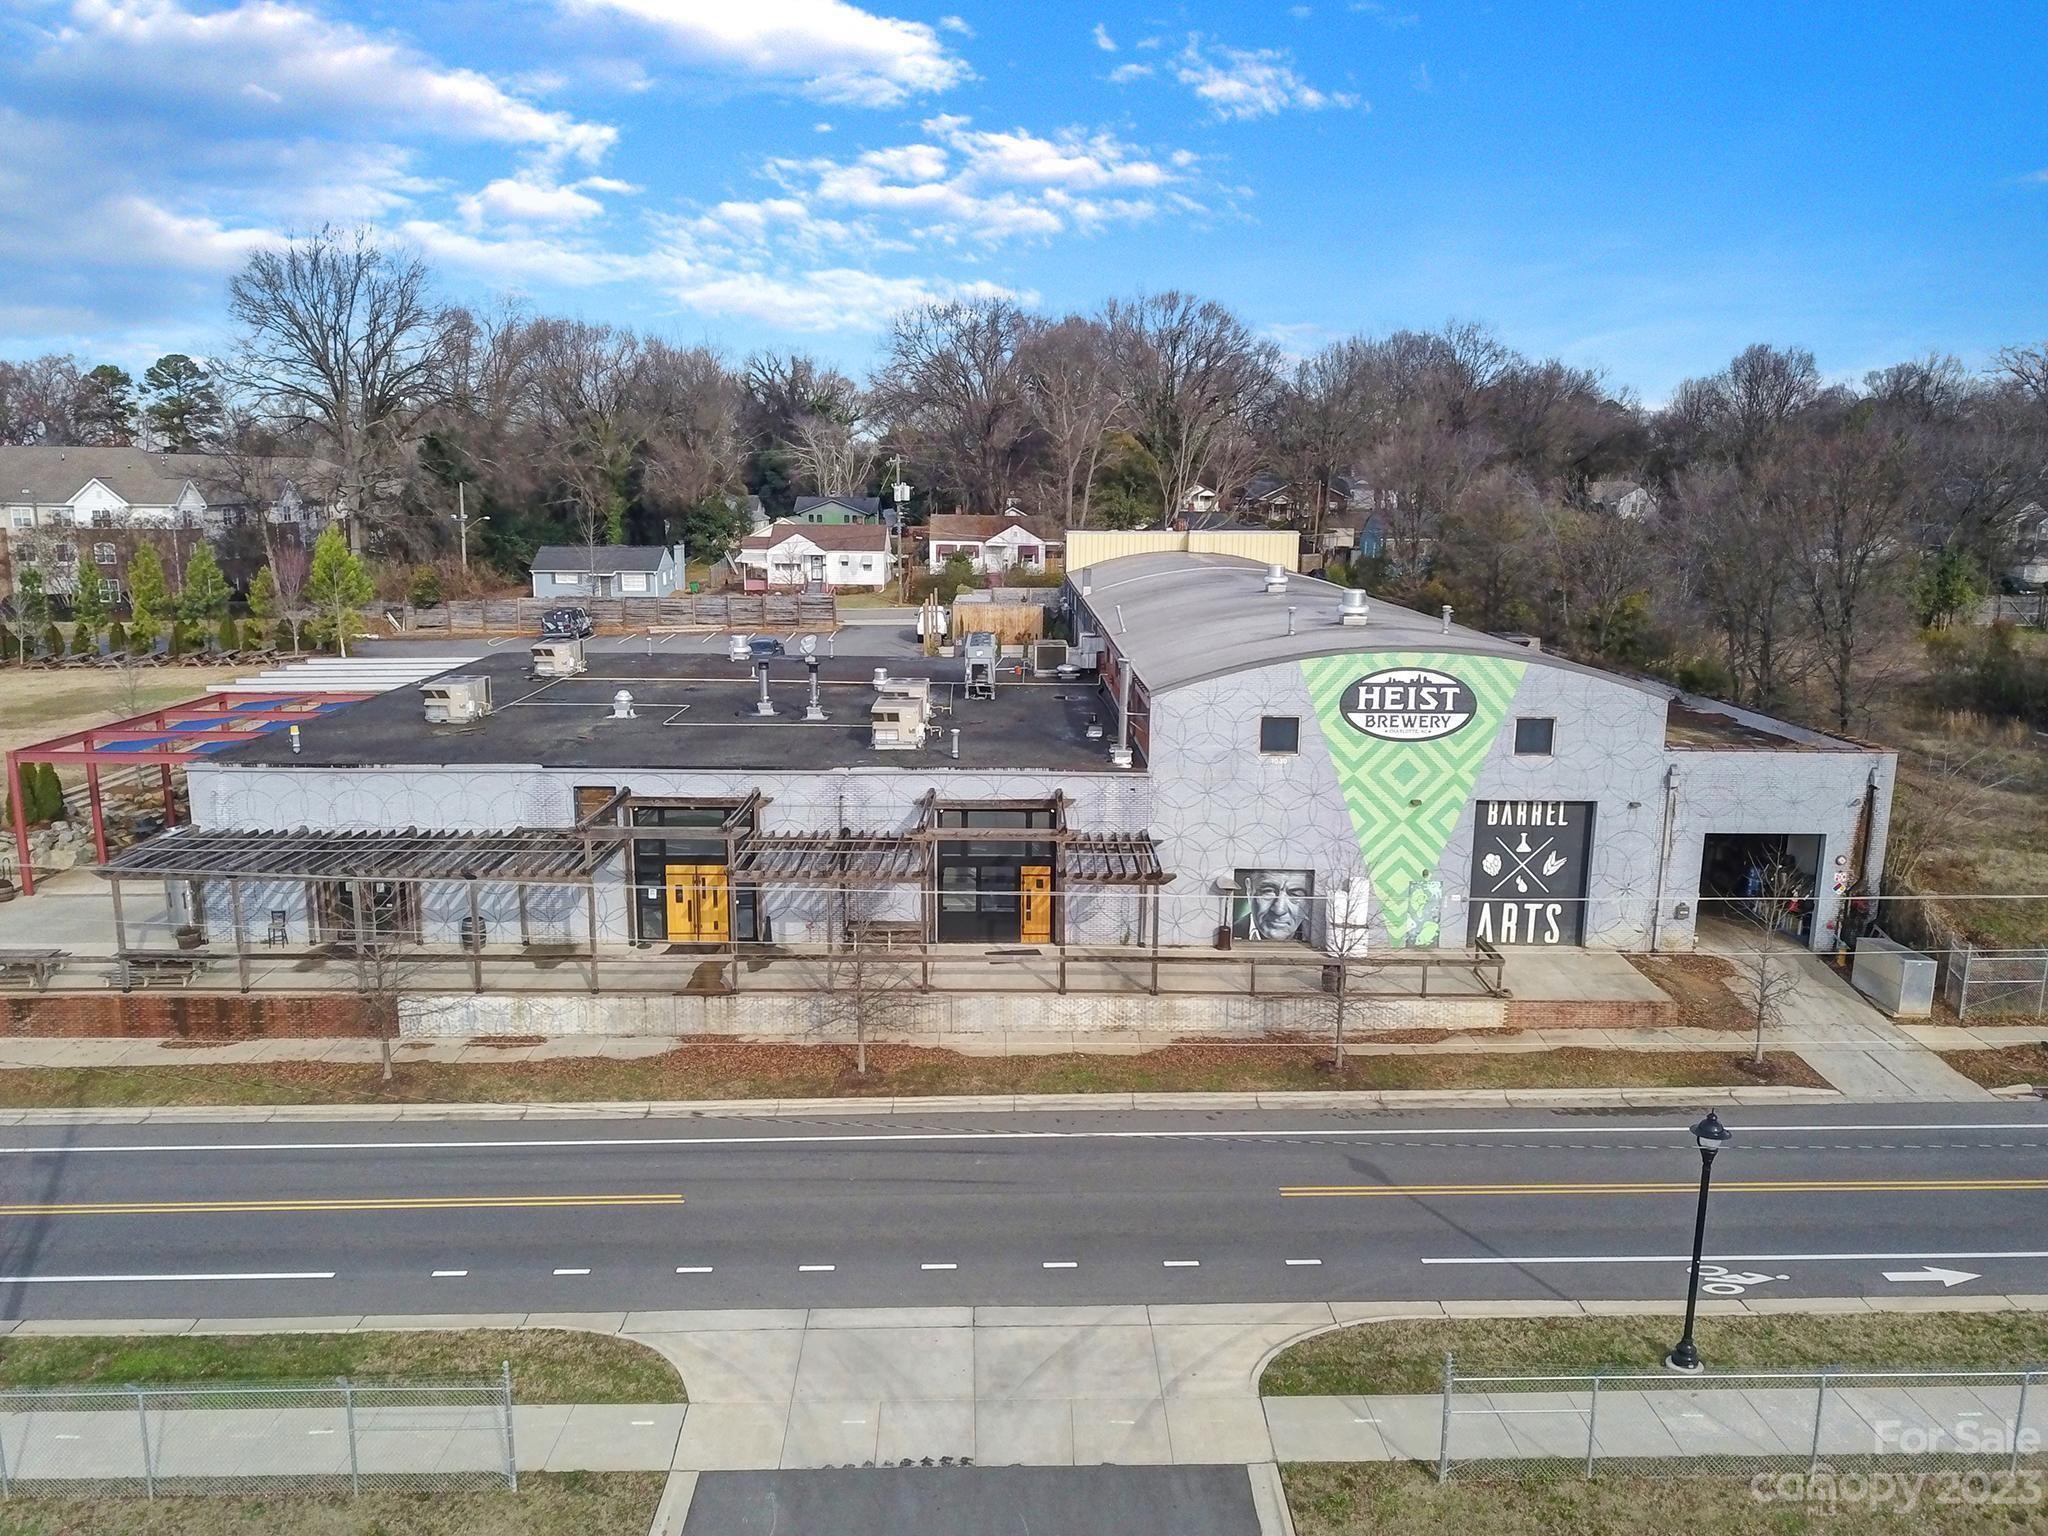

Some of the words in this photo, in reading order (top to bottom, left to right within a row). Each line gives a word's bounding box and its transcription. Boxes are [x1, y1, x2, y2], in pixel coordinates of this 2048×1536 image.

[1357, 686, 1460, 711] HEIST
[1365, 715, 1451, 728] BREWERY
[1487, 801, 1568, 826] BARREL
[1477, 902, 1562, 944] ARTS
